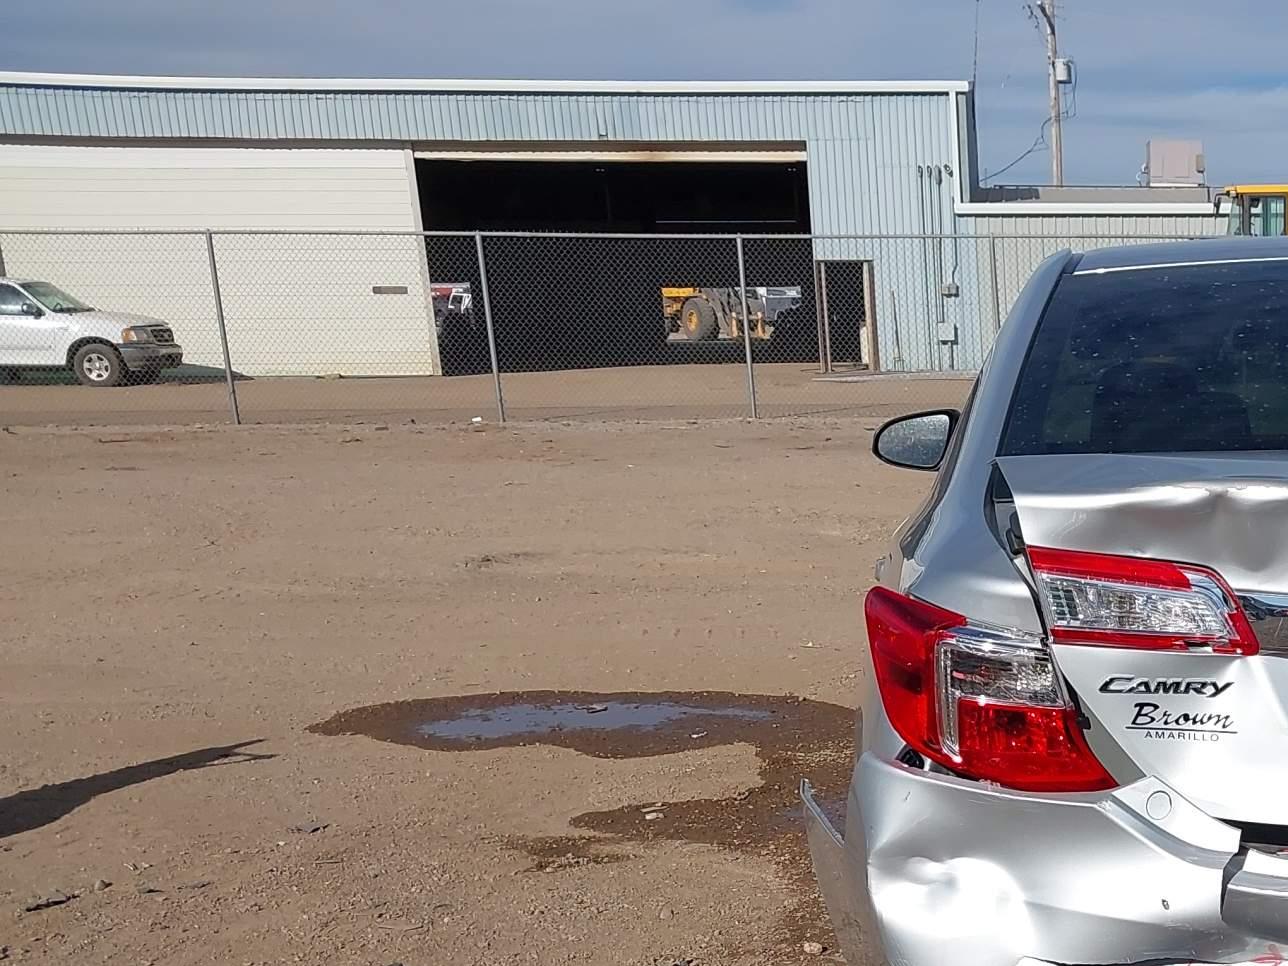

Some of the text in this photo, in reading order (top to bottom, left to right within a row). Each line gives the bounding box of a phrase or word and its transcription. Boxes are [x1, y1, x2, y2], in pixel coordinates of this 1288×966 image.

[1098, 674, 1235, 698] CAMRY
[1131, 702, 1234, 729] Brown
[1144, 732, 1219, 742] AMARILLO
